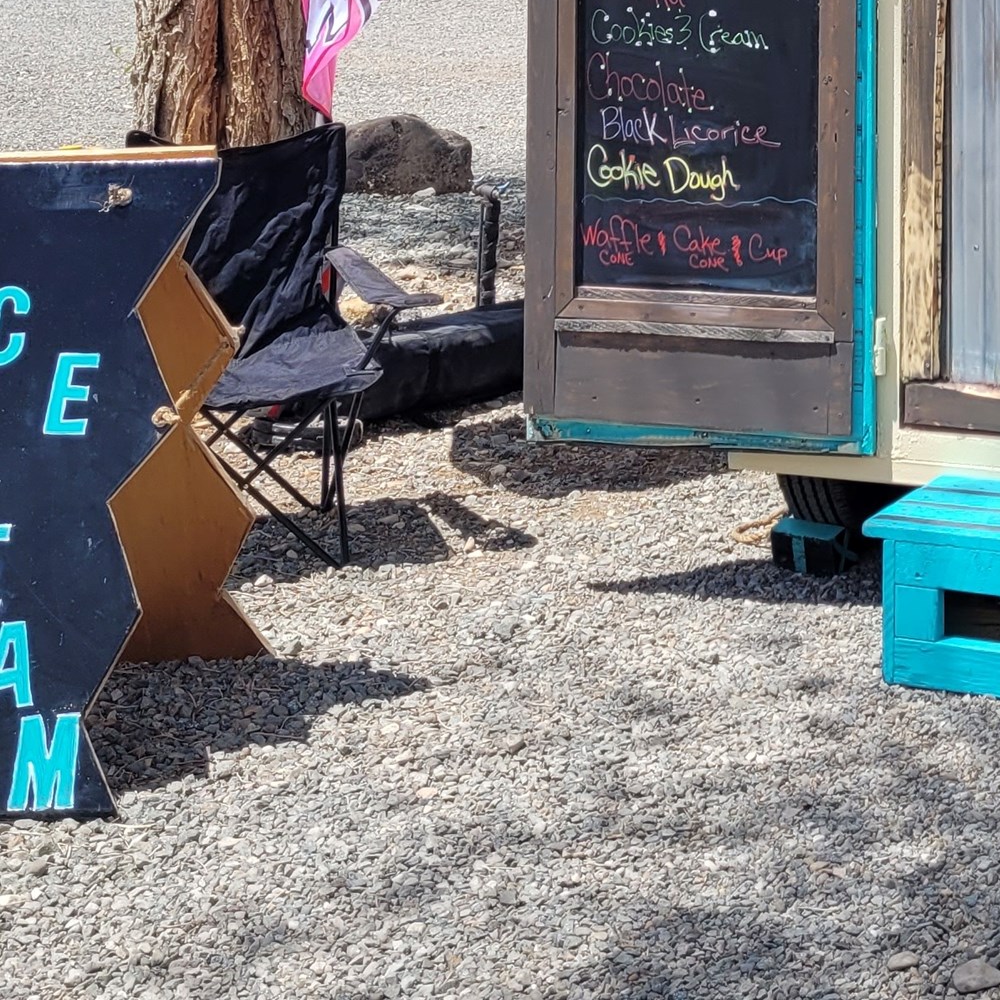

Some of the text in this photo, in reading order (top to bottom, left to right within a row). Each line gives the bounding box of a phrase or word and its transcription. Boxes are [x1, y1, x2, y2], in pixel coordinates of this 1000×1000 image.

[592, 6, 674, 47] Cookies
[699, 9, 769, 53] Cream
[587, 51, 714, 113] Chocolate
[601, 106, 781, 149] Black Licorice
[587, 144, 741, 200] Cookie Dough
[581, 215, 653, 255] Waffle
[673, 224, 725, 255] Cake
[749, 233, 788, 266] Cup
